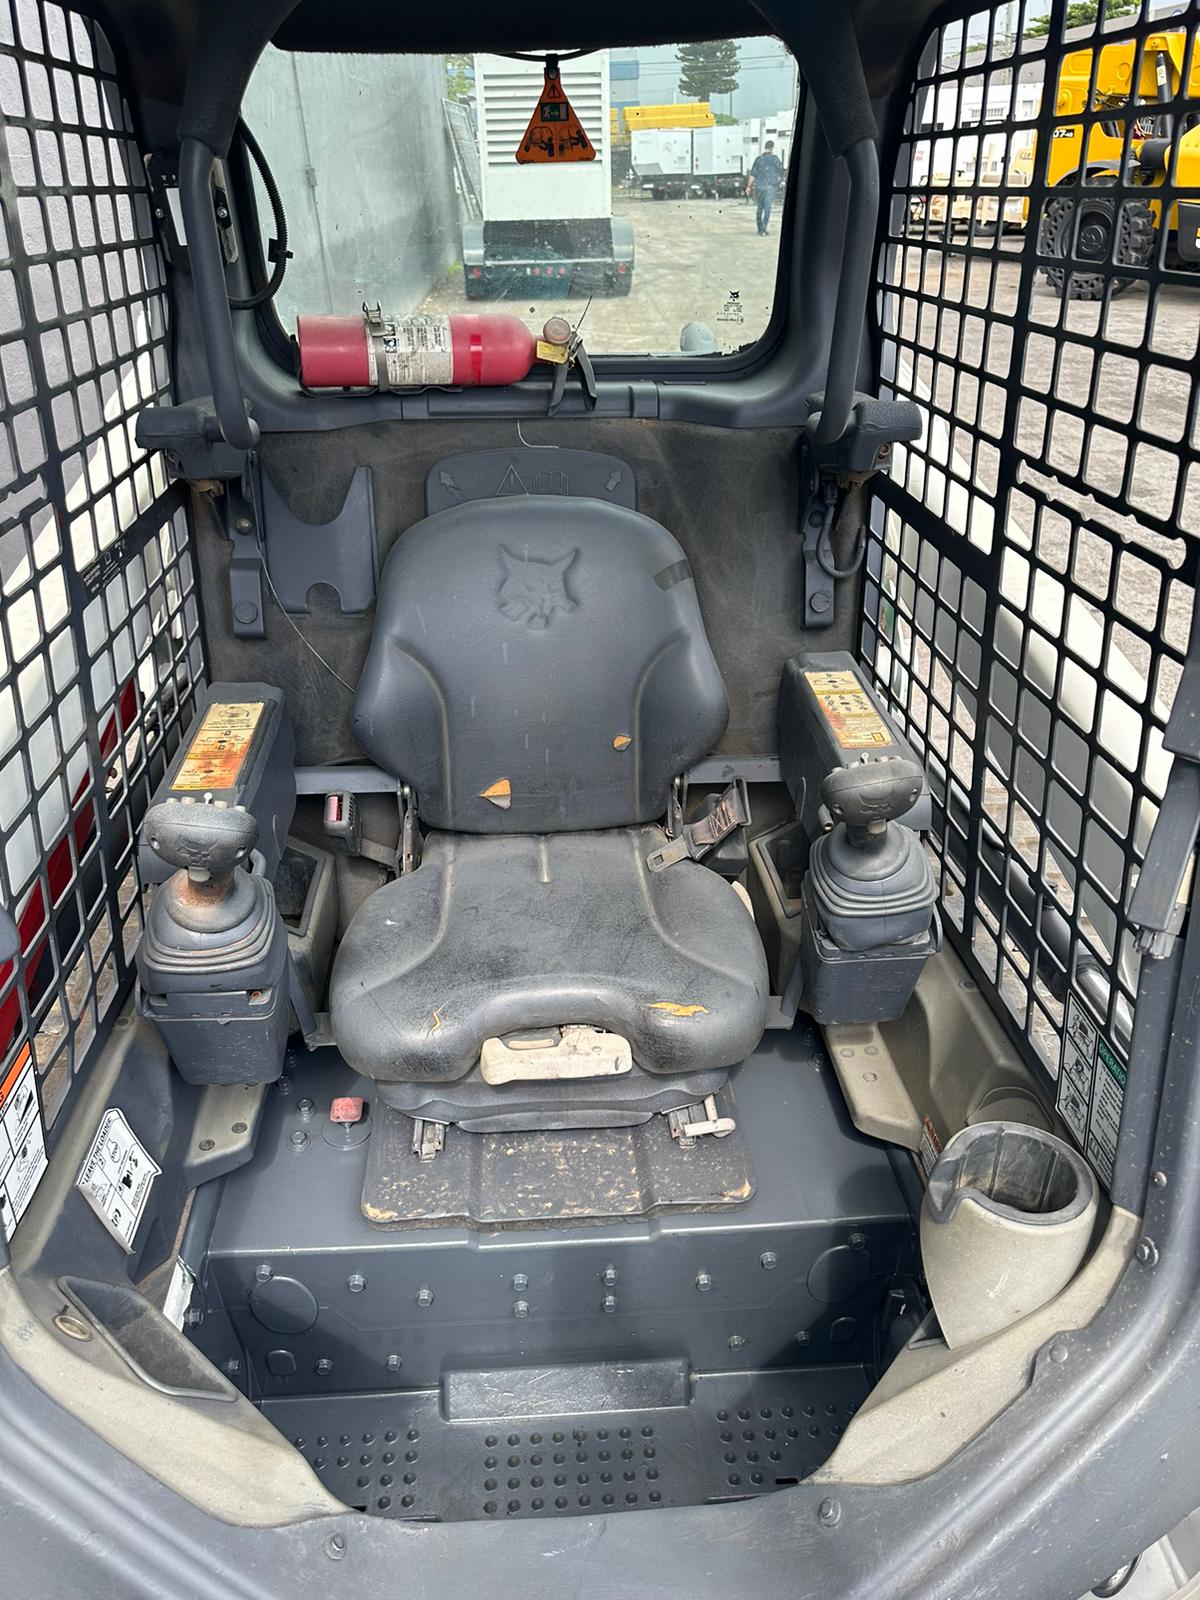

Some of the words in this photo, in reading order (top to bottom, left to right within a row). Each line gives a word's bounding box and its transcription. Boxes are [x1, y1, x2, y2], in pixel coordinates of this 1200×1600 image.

[1099, 1043, 1126, 1085] OPERATIO
[84, 1159, 95, 1183] LEAVE
[93, 1145, 101, 1160] THE
